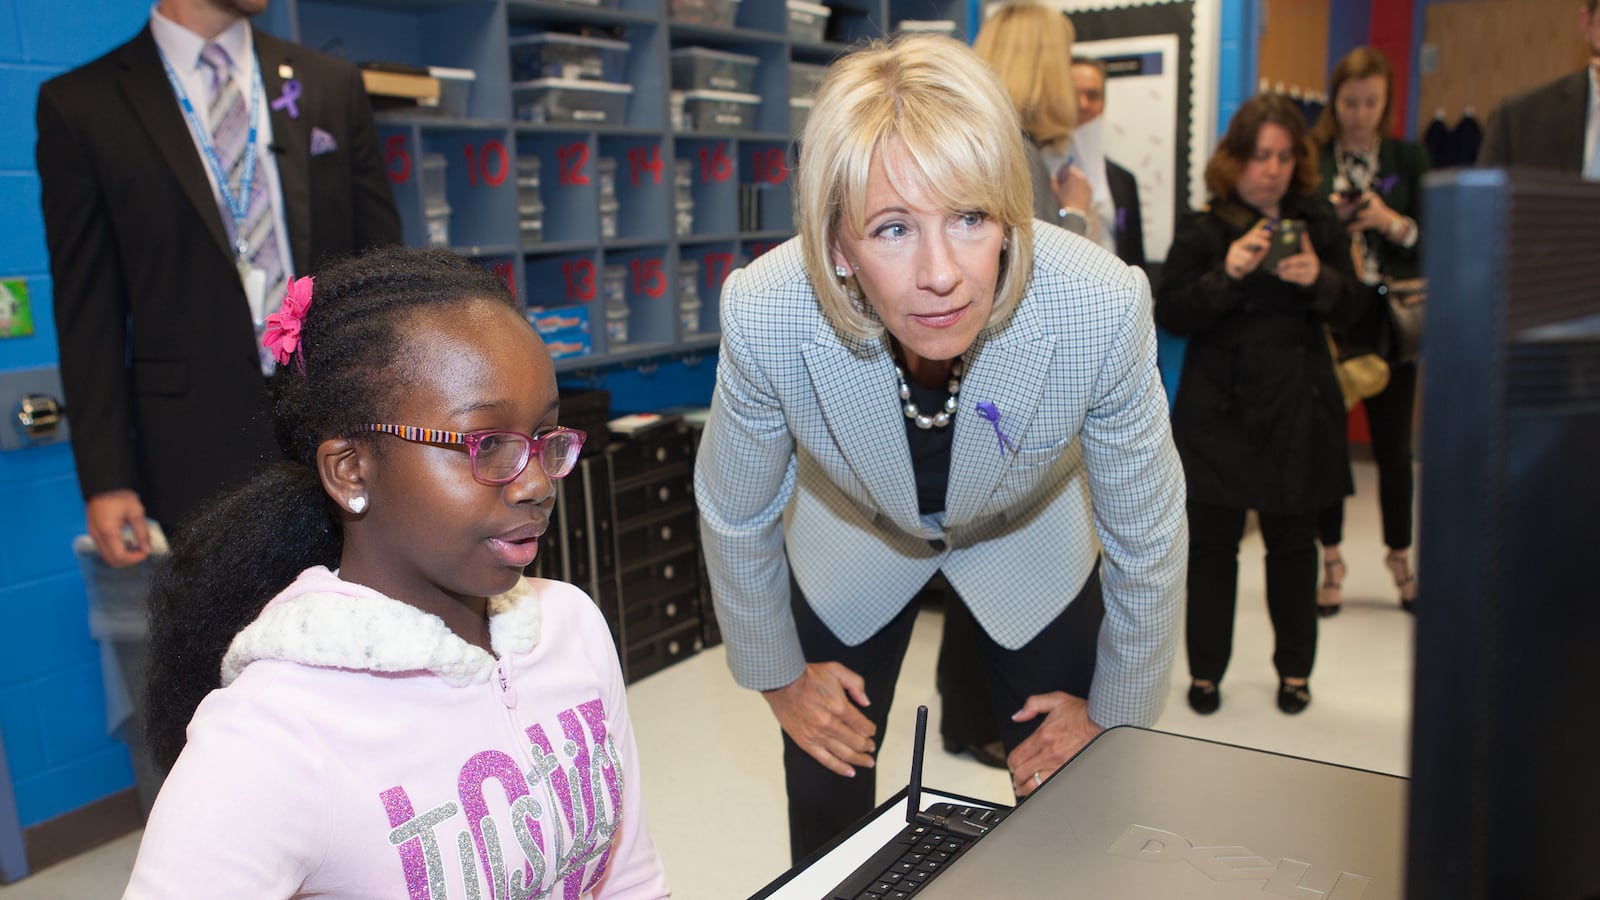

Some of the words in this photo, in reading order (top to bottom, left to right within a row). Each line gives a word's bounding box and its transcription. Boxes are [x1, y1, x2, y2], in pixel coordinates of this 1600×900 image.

[385, 133, 412, 185] 5
[464, 139, 509, 188] 10
[557, 142, 591, 187] 12
[628, 144, 665, 187] 14
[698, 142, 733, 184] 16
[752, 147, 788, 185] 18
[562, 258, 597, 302] 13
[631, 258, 667, 298] 15
[704, 252, 734, 288] 17
